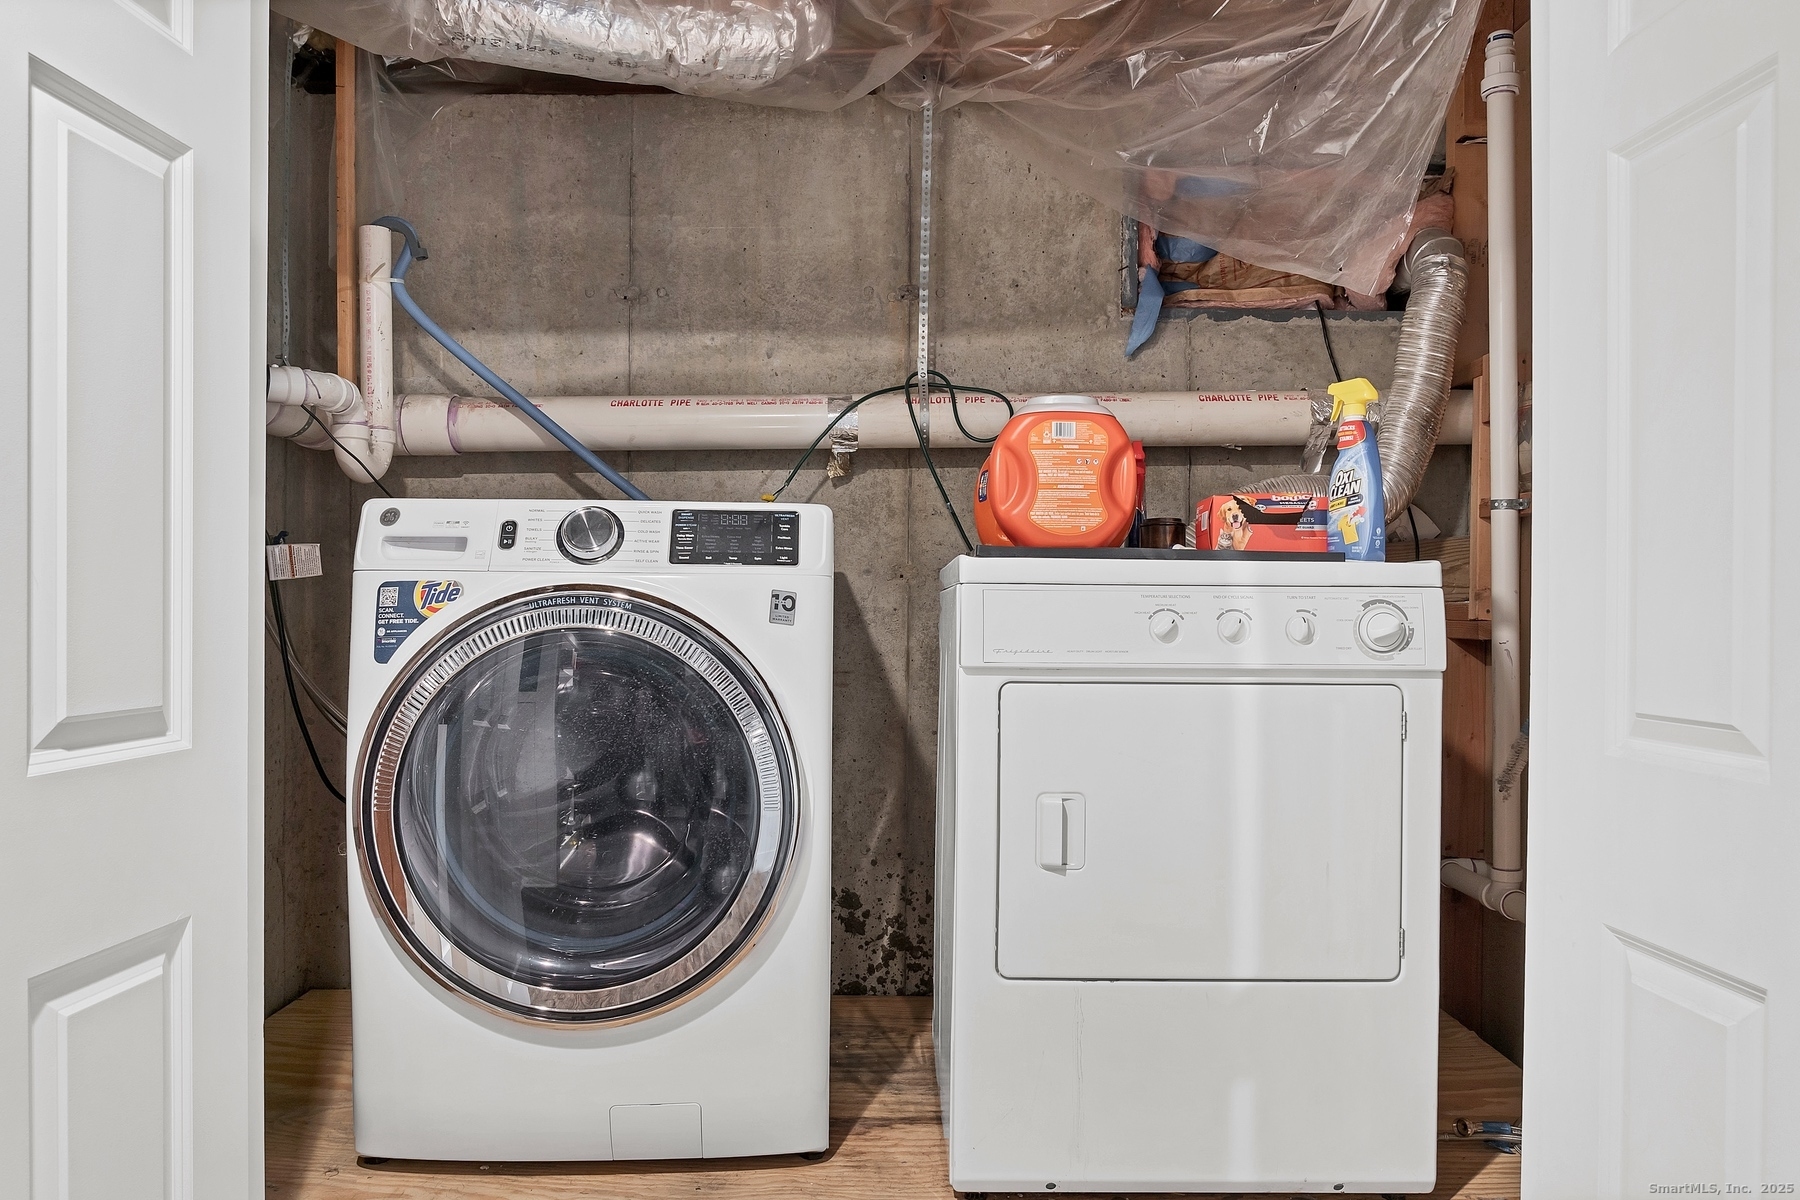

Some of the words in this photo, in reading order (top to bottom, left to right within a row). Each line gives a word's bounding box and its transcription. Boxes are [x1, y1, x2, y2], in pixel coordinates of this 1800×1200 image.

[610, 399, 664, 407] CHARLOTTE
[670, 399, 691, 407] PIPE
[964, 396, 986, 404] PIPE
[1198, 394, 1252, 402] CHARLOTTE
[1257, 393, 1279, 401] PIPE
[1335, 469, 1355, 486] OXI
[1330, 479, 1362, 500] CLEAN
[420, 581, 461, 610] Tide
[528, 597, 576, 609] ULTRAFRESH
[580, 596, 600, 604] VENT
[603, 598, 632, 610] SYSTEM
[992, 648, 1054, 656] Frigidaire
